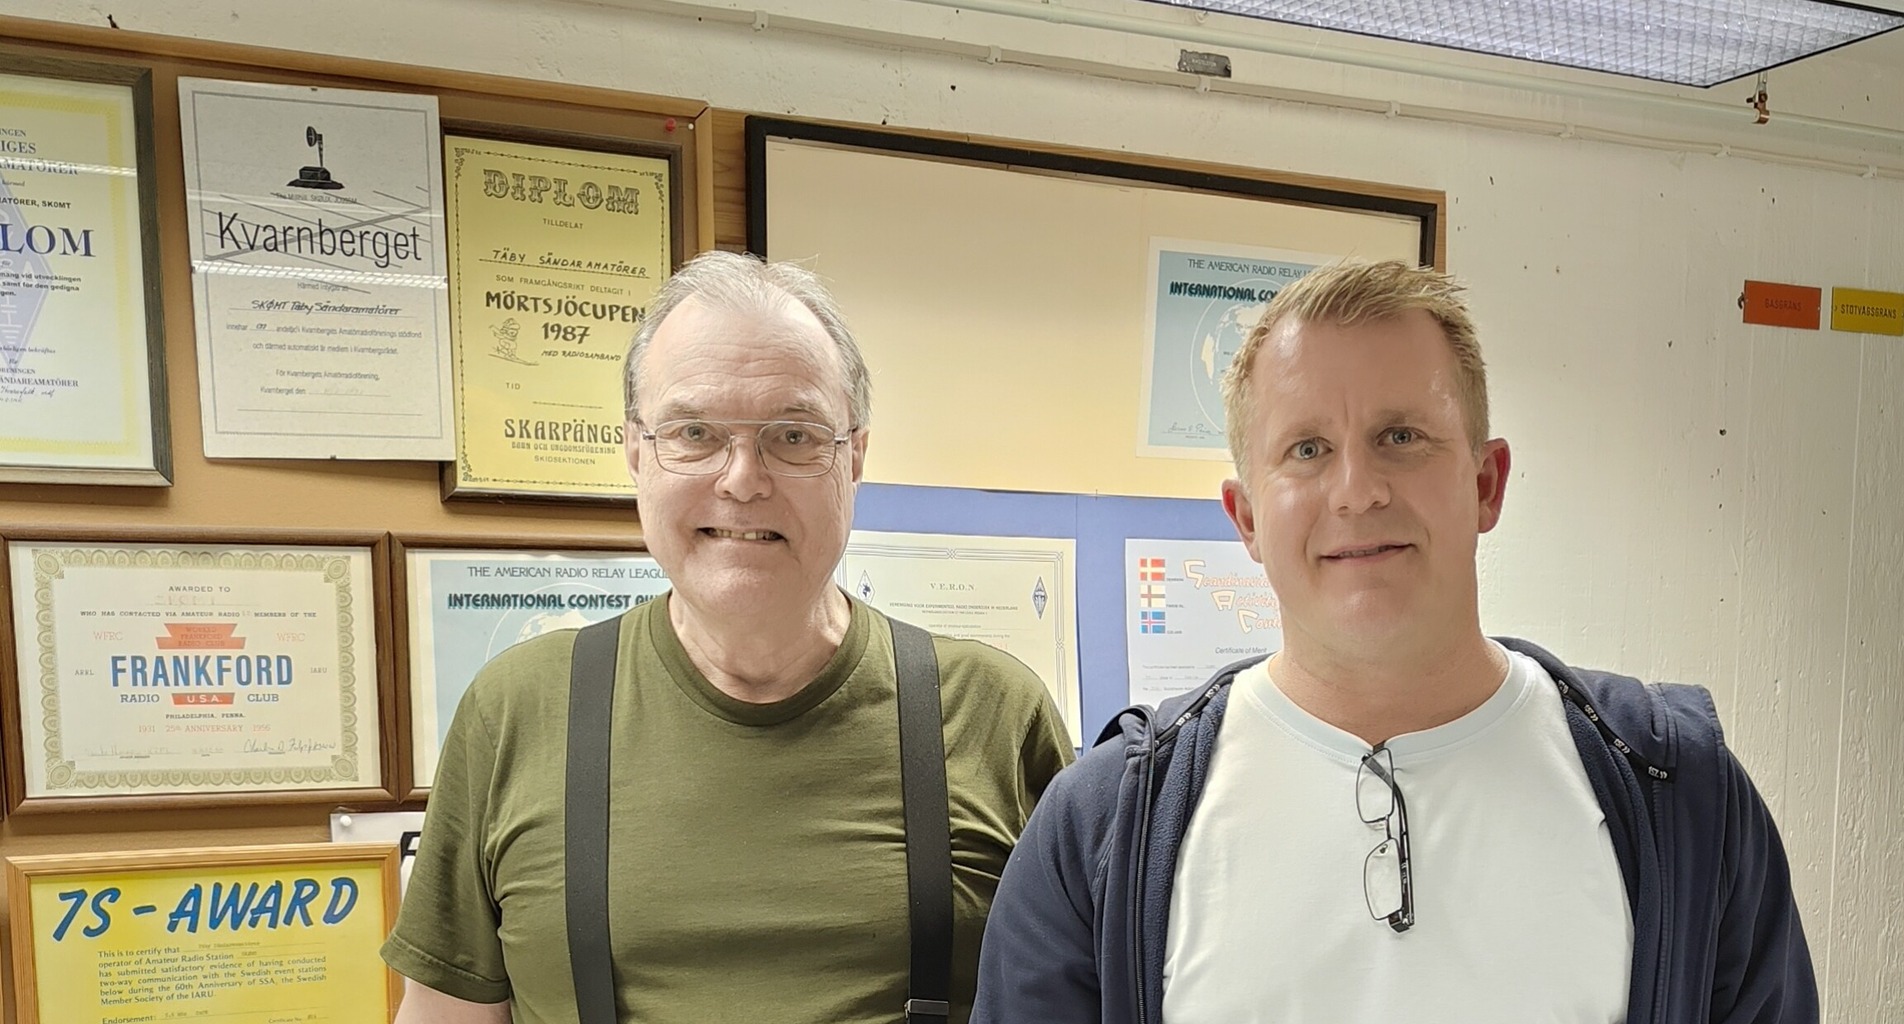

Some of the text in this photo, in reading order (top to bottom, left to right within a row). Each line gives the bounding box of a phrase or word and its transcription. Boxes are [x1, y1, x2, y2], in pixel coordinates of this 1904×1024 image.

[483, 168, 640, 215] DIPLOM
[0, 198, 40, 208] ATÖRER,
[542, 217, 584, 230] TILLDELAT
[218, 211, 422, 268] Kvarnberget
[492, 247, 526, 263] TÄBY
[1187, 258, 1205, 270] THE
[1207, 260, 1250, 274] AMERICAN
[1251, 265, 1277, 276] RADIO
[496, 274, 624, 295] SOM FRAMGÅNGSRIKT DELTAGIT
[1169, 281, 1257, 302] INTERNATIONAL
[485, 290, 647, 323] MÖRTSJÖCUPEN
[541, 322, 591, 345] 1987
[505, 382, 521, 390] TID
[504, 418, 624, 445] SKARPÄNGS
[534, 455, 596, 465] SKIDSEKTIONEN
[467, 566, 491, 577] THE
[494, 566, 551, 578] AMERICAN
[555, 567, 589, 578] RADIO
[592, 567, 626, 579] RELAY
[168, 585, 213, 593] AWARDED
[448, 593, 565, 610] INTERNATIONAL
[567, 593, 632, 609] CONTEST
[111, 655, 293, 687] FRANKFORD
[120, 693, 160, 704] RADIO
[247, 693, 280, 702] CLUB
[98, 946, 180, 958] This certify that
[98, 960, 131, 969] operator
[145, 957, 178, 965] Amateur
[181, 955, 204, 963] Radio
[205, 953, 234, 961] Station
[117, 956, 327, 976] submitted satisfactory evidence conducted
[137, 965, 327, 984] communication Swedish stations
[101, 994, 164, 1005] Member Society
